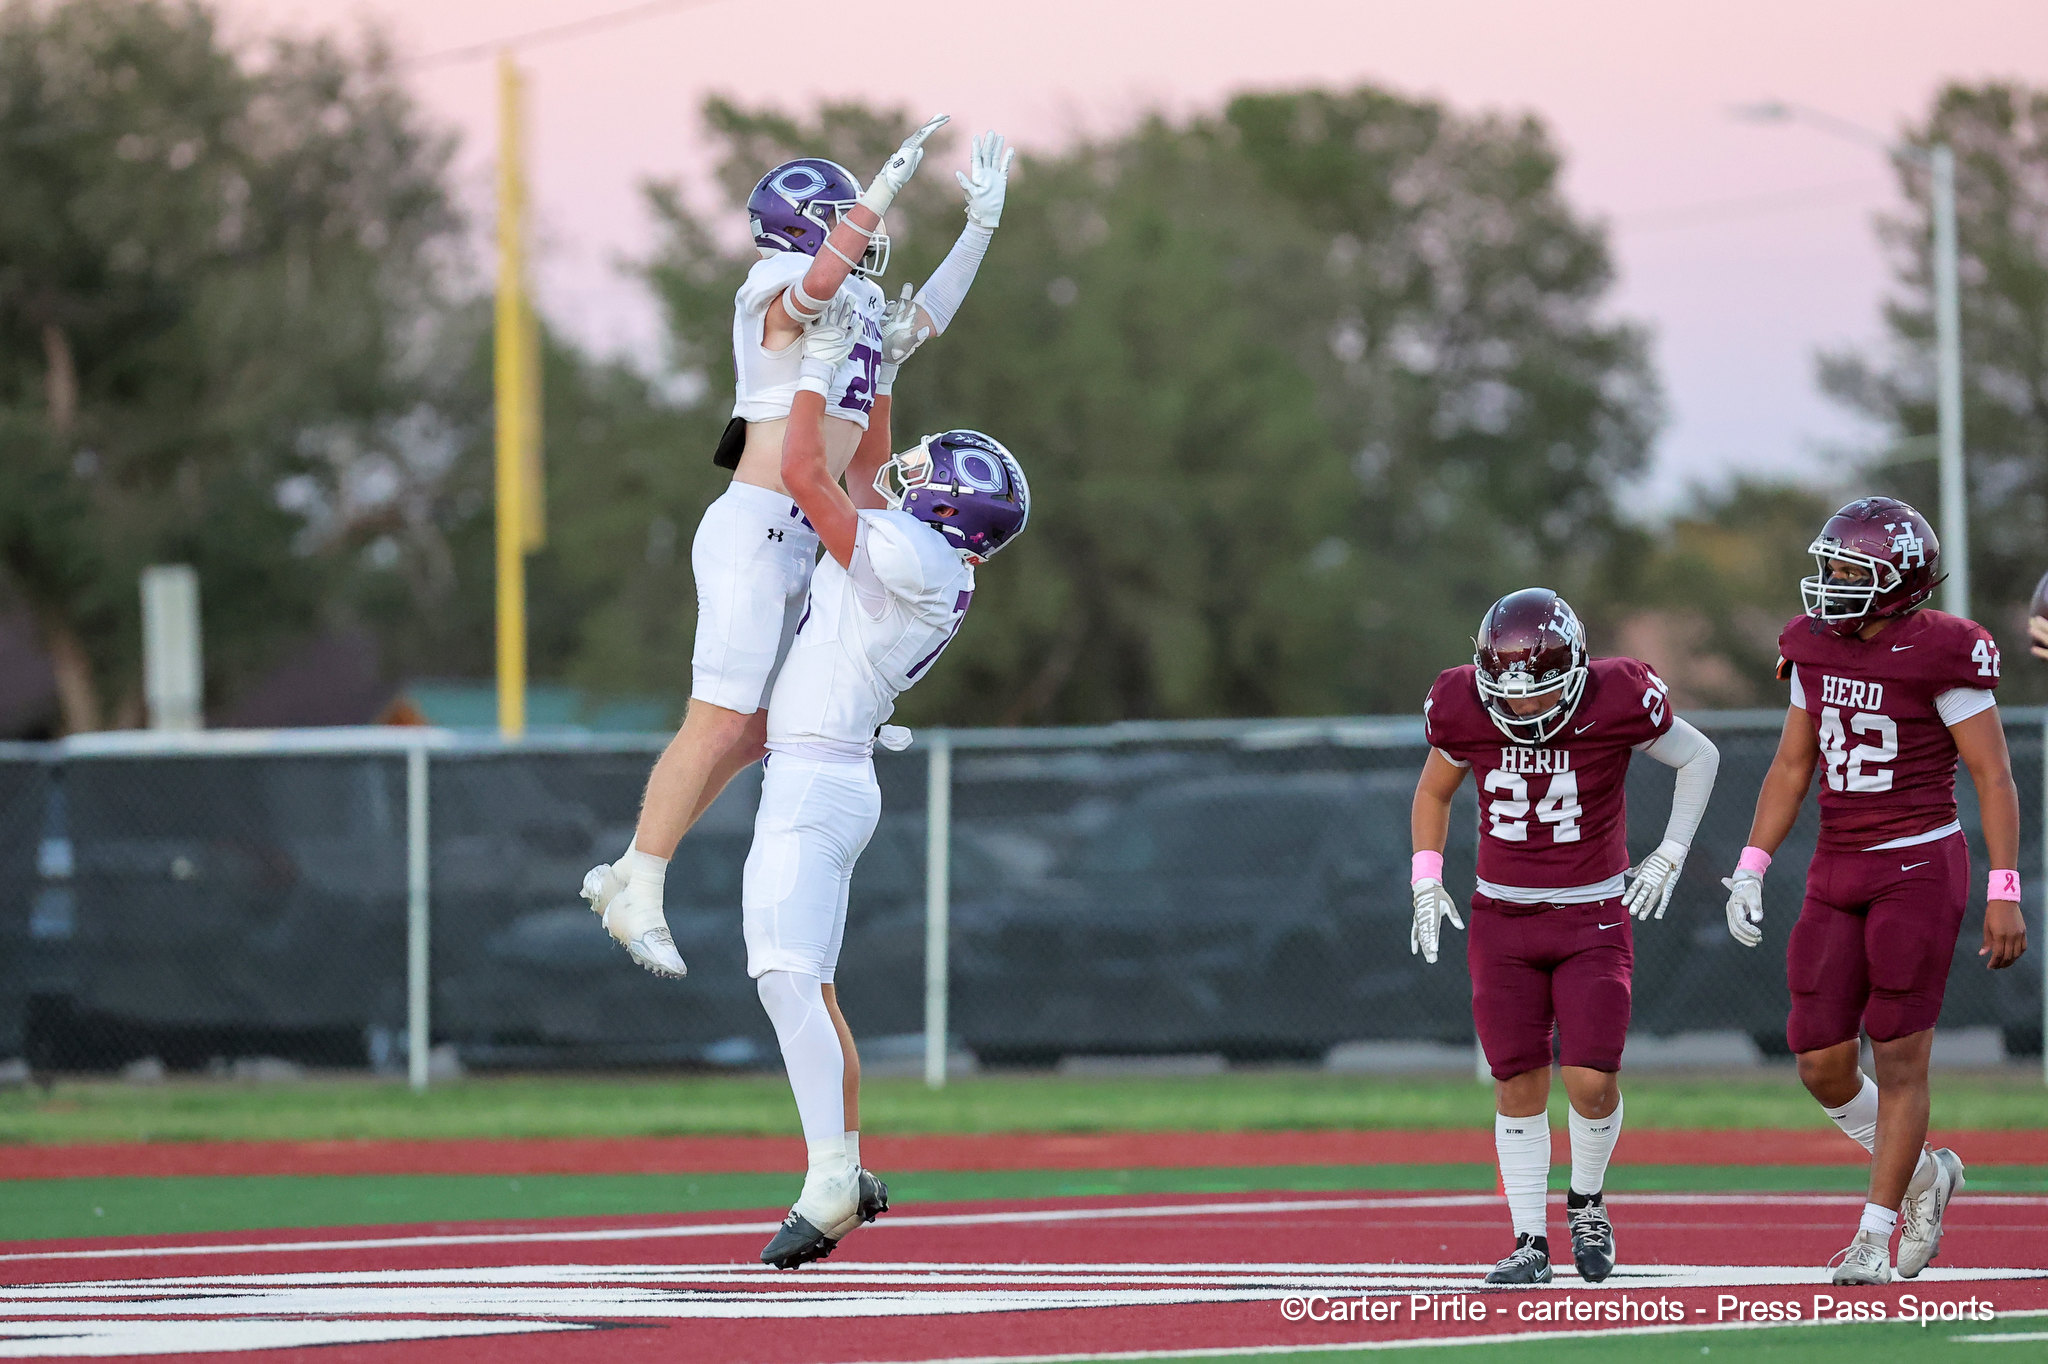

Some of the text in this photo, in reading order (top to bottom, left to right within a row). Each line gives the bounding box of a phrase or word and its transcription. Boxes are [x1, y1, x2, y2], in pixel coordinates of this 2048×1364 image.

[1820, 674, 1884, 711] HERD
[1500, 746, 1570, 774] HERD
[1818, 705, 1898, 793] 42
[1483, 768, 1583, 843] 24
